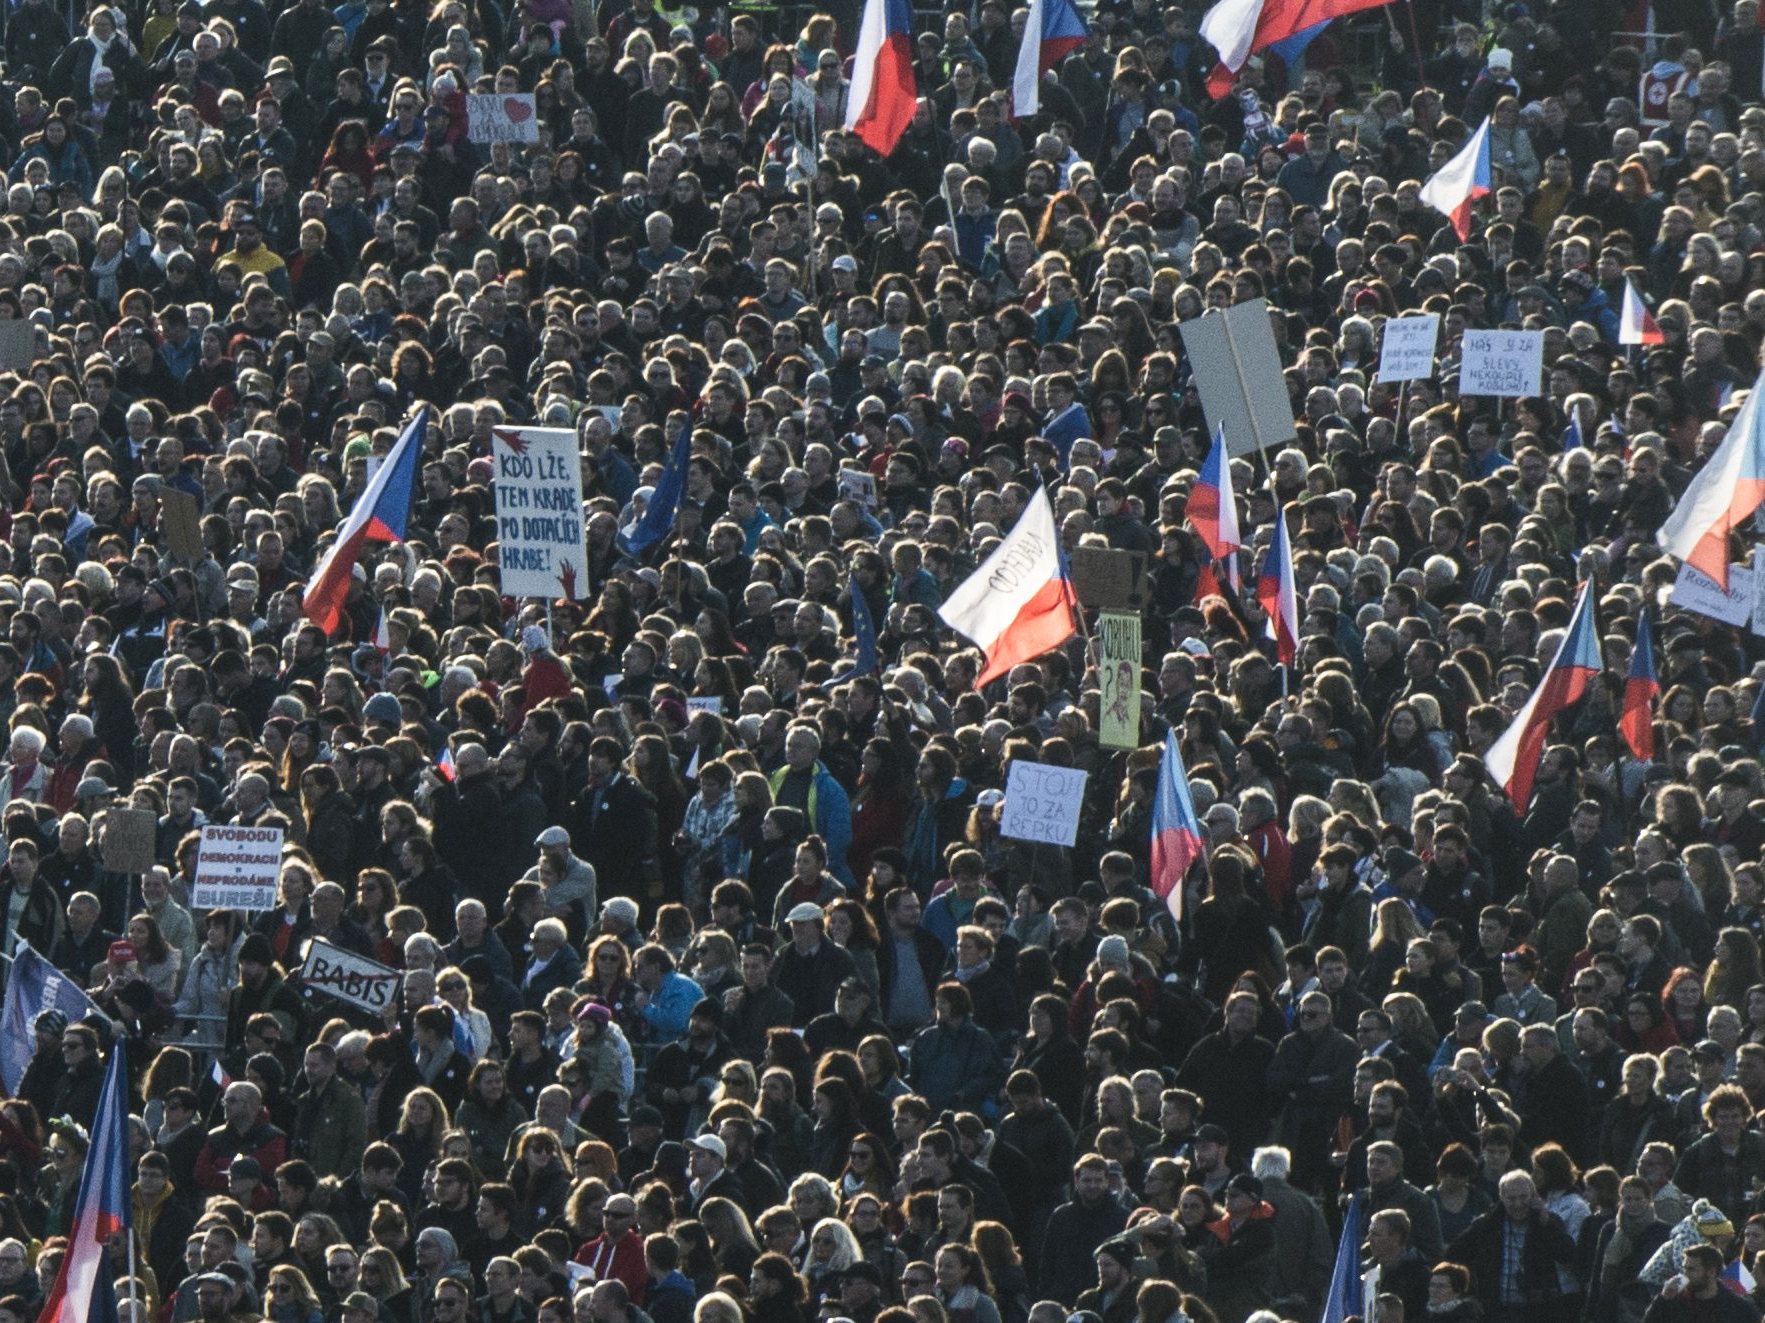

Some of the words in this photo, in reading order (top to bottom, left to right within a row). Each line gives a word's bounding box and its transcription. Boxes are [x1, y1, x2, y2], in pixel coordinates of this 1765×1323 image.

[501, 454, 534, 480] KDO
[499, 487, 531, 511] TEN
[502, 517, 520, 543] PO
[503, 547, 552, 572] HRABE!
[204, 828, 279, 843] SVOBODU
